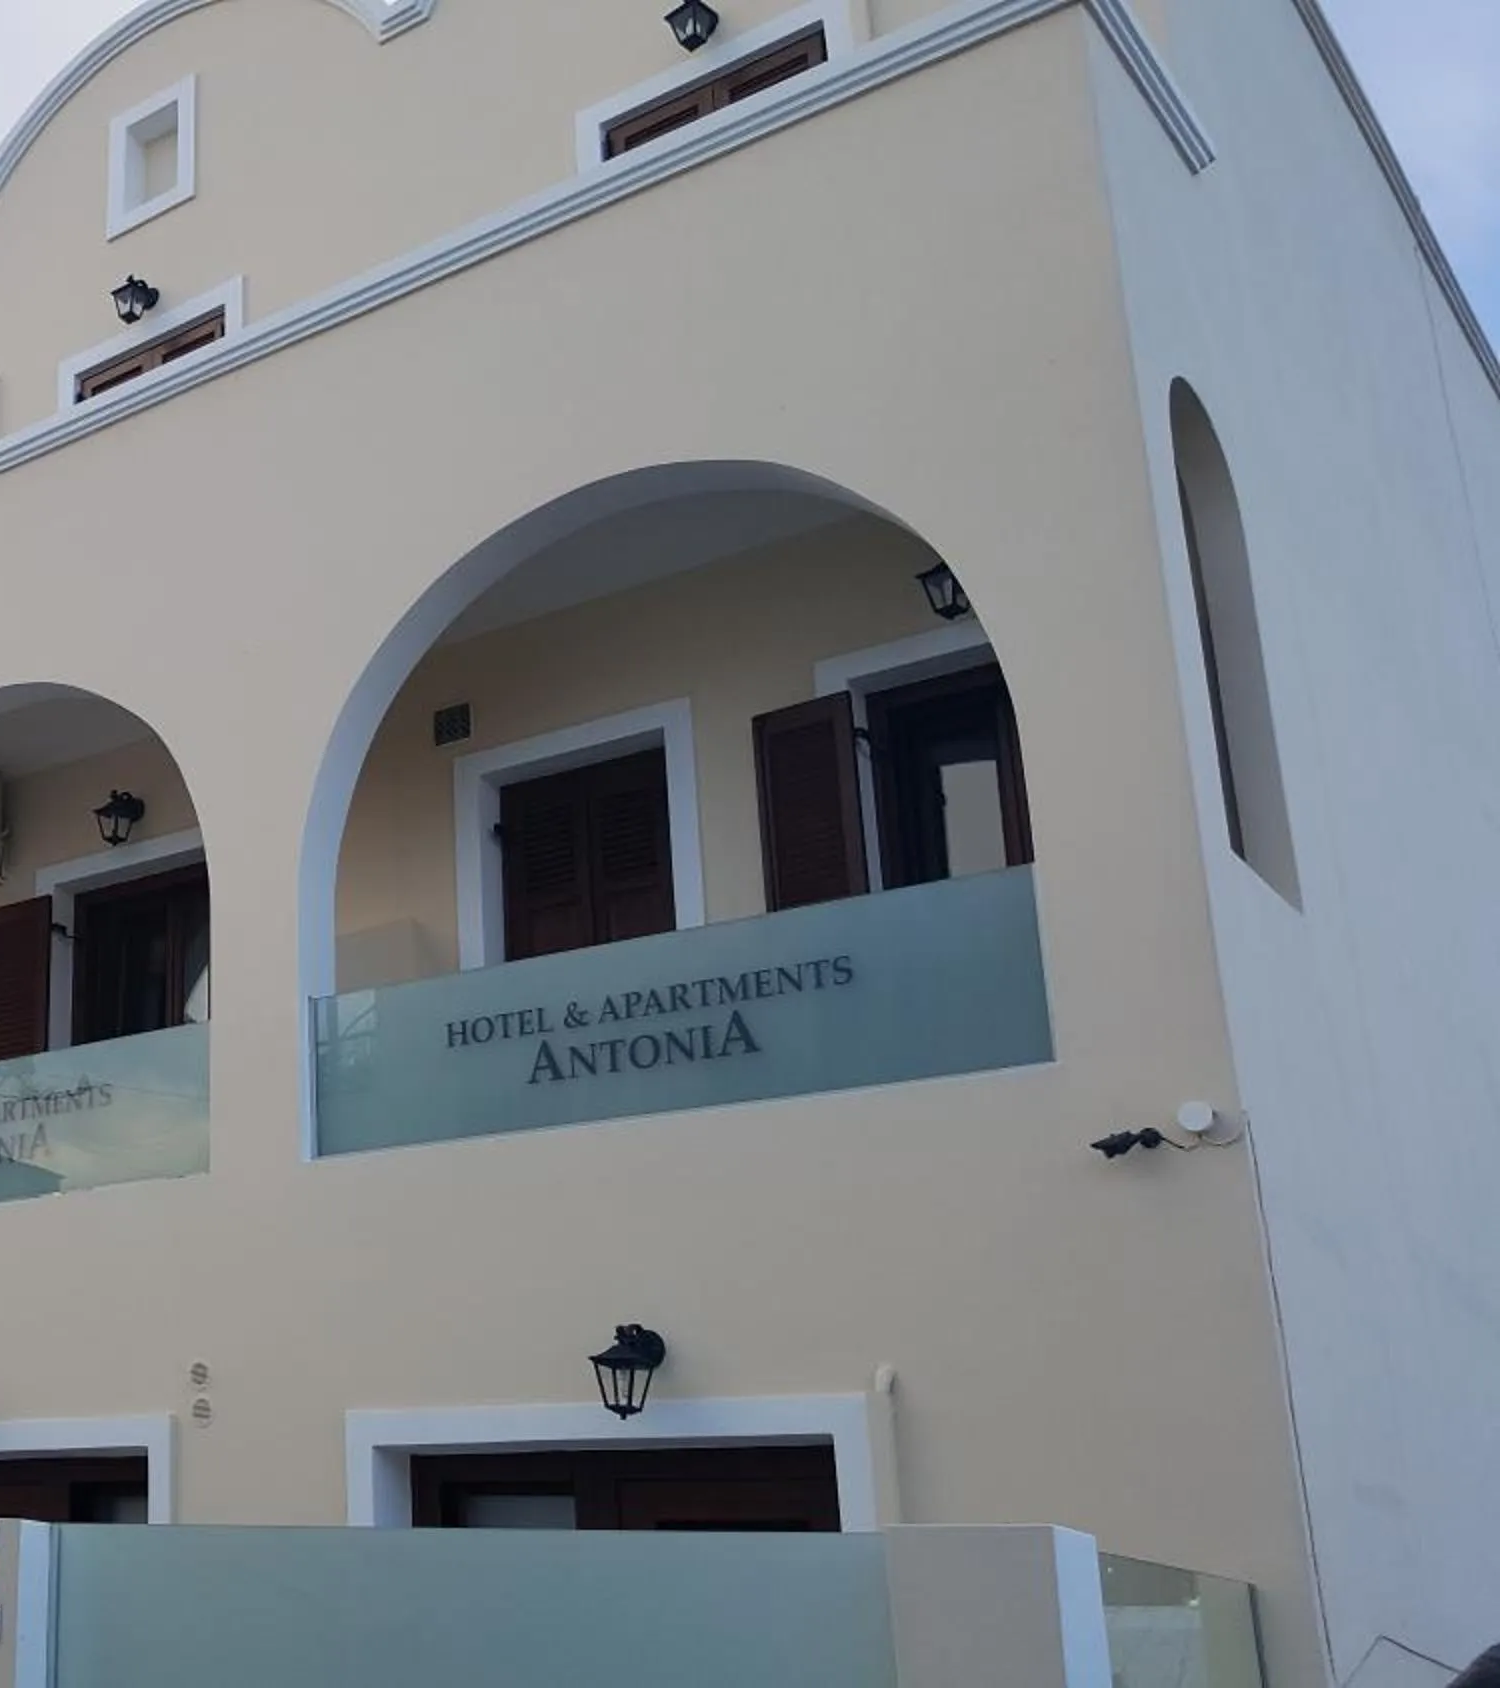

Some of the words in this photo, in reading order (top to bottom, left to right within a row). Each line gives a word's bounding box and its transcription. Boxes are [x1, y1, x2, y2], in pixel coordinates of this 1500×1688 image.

[446, 1007, 553, 1048] HOTEL
[563, 1001, 589, 1029] &
[598, 955, 853, 1025] APARTMENTS
[527, 1009, 762, 1085] ANTONIA
